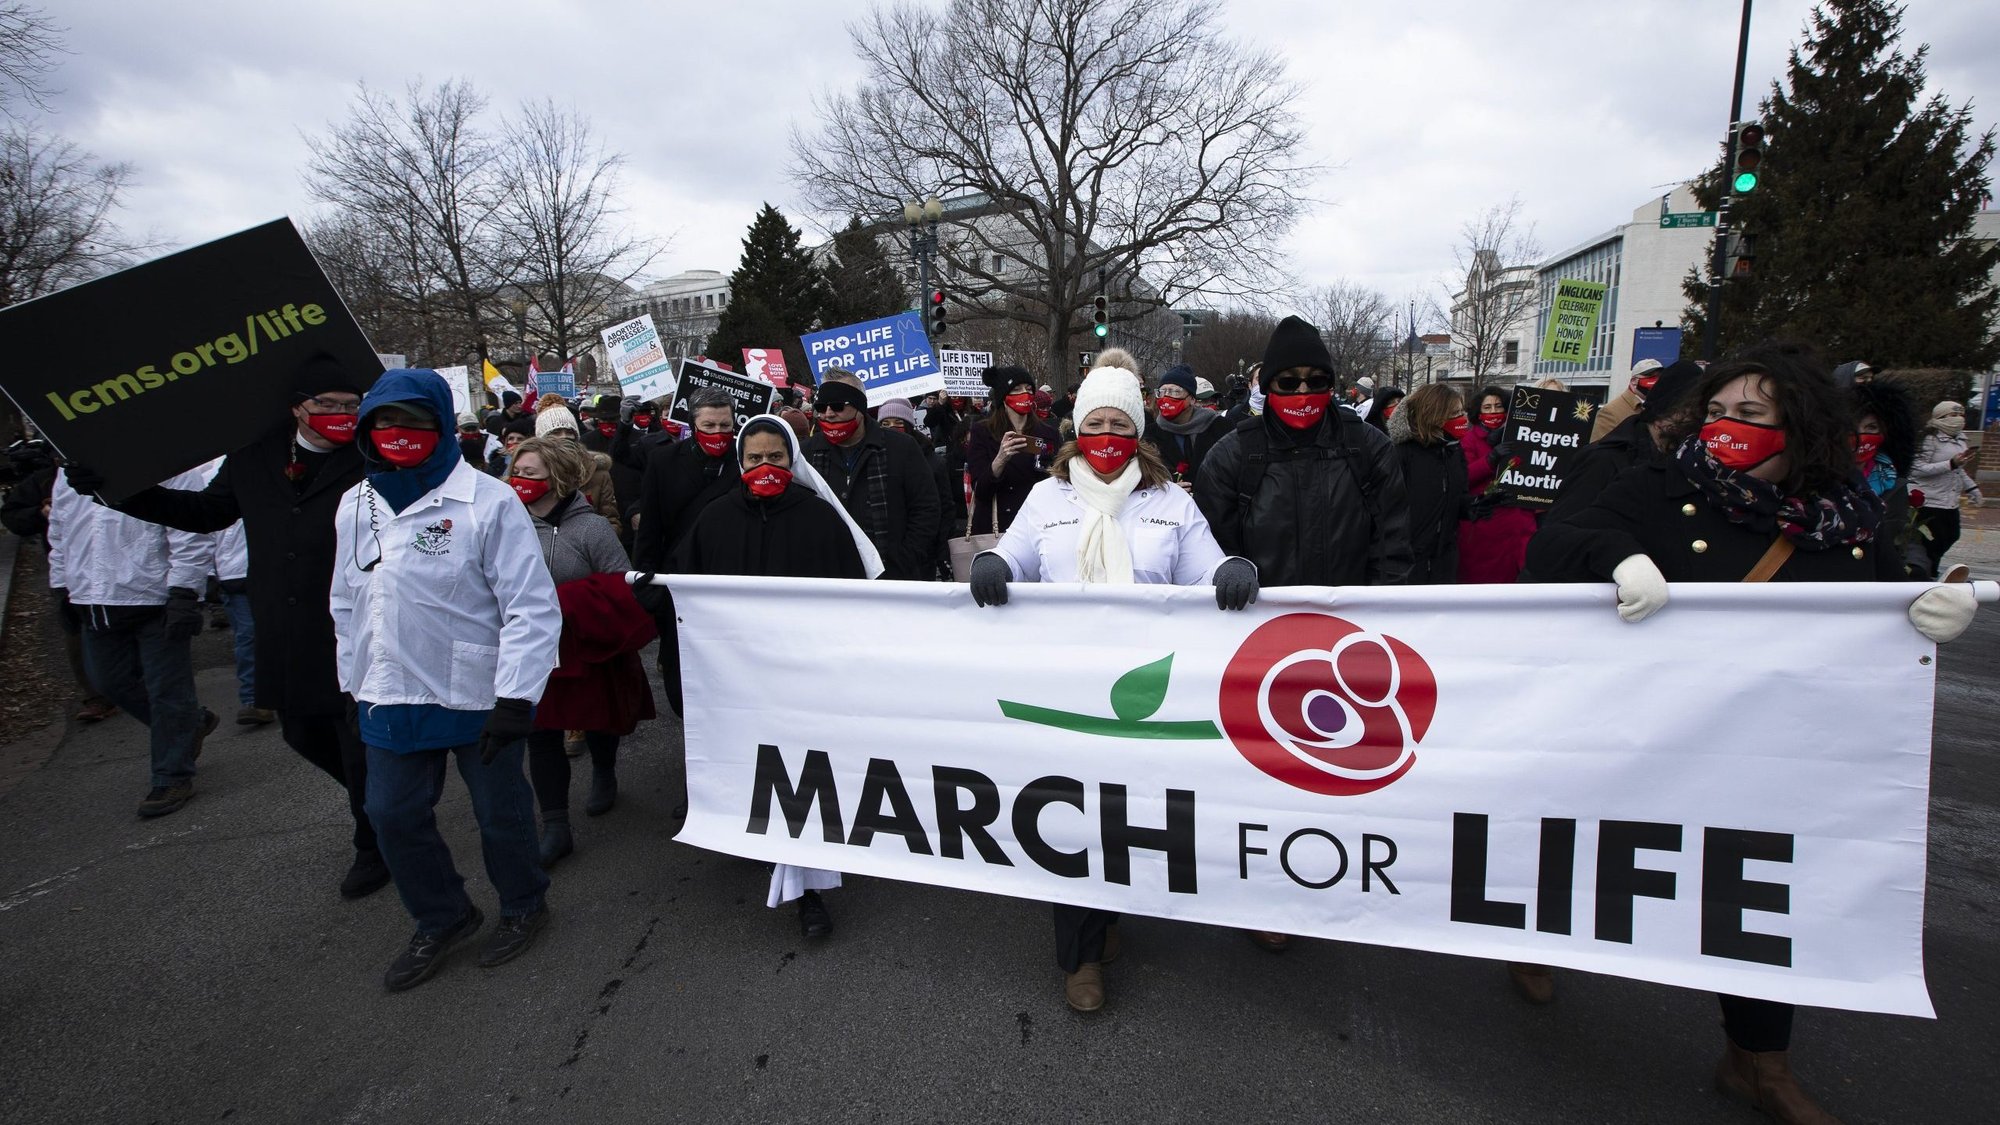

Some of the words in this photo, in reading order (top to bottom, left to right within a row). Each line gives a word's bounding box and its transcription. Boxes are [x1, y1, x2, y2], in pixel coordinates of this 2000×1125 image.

[1558, 285, 1604, 301] ANGLICANS
[1558, 300, 1597, 314] CELEBRATE
[1557, 314, 1590, 327] PROTECT
[607, 319, 642, 342] ABORTION
[607, 325, 648, 348] OPPRESSES:
[1556, 328, 1584, 340] HONOR
[624, 331, 656, 351] MOTHERS
[649, 340, 657, 350] &
[811, 326, 893, 356] PRO-LIFE
[1552, 340, 1581, 355] LIFE
[46, 303, 327, 421] lcms.org/life
[625, 350, 662, 373] CHILDREN
[817, 353, 855, 373] FOR
[860, 344, 895, 363] THE
[894, 354, 931, 374] LIFE
[942, 353, 959, 363] LIFE
[961, 353, 969, 364] IS
[970, 354, 986, 364] THE
[558, 375, 573, 383] LOVE
[943, 366, 963, 376] FIRST
[709, 372, 734, 384] STUDENTS
[734, 379, 745, 388] FOR
[688, 375, 709, 388] THE
[752, 394, 762, 404] IS
[1283, 408, 1305, 417] MARCH
[1549, 407, 1557, 422] I
[1517, 426, 1579, 448] Regret
[1090, 449, 1107, 459] MARCH
[1731, 442, 1749, 450] LIFE
[1530, 450, 1557, 471] My
[413, 544, 437, 556] RESPECT
[746, 743, 1198, 895] MARCH
[1238, 822, 1400, 896] FOR
[1450, 812, 1794, 968] LIFE
